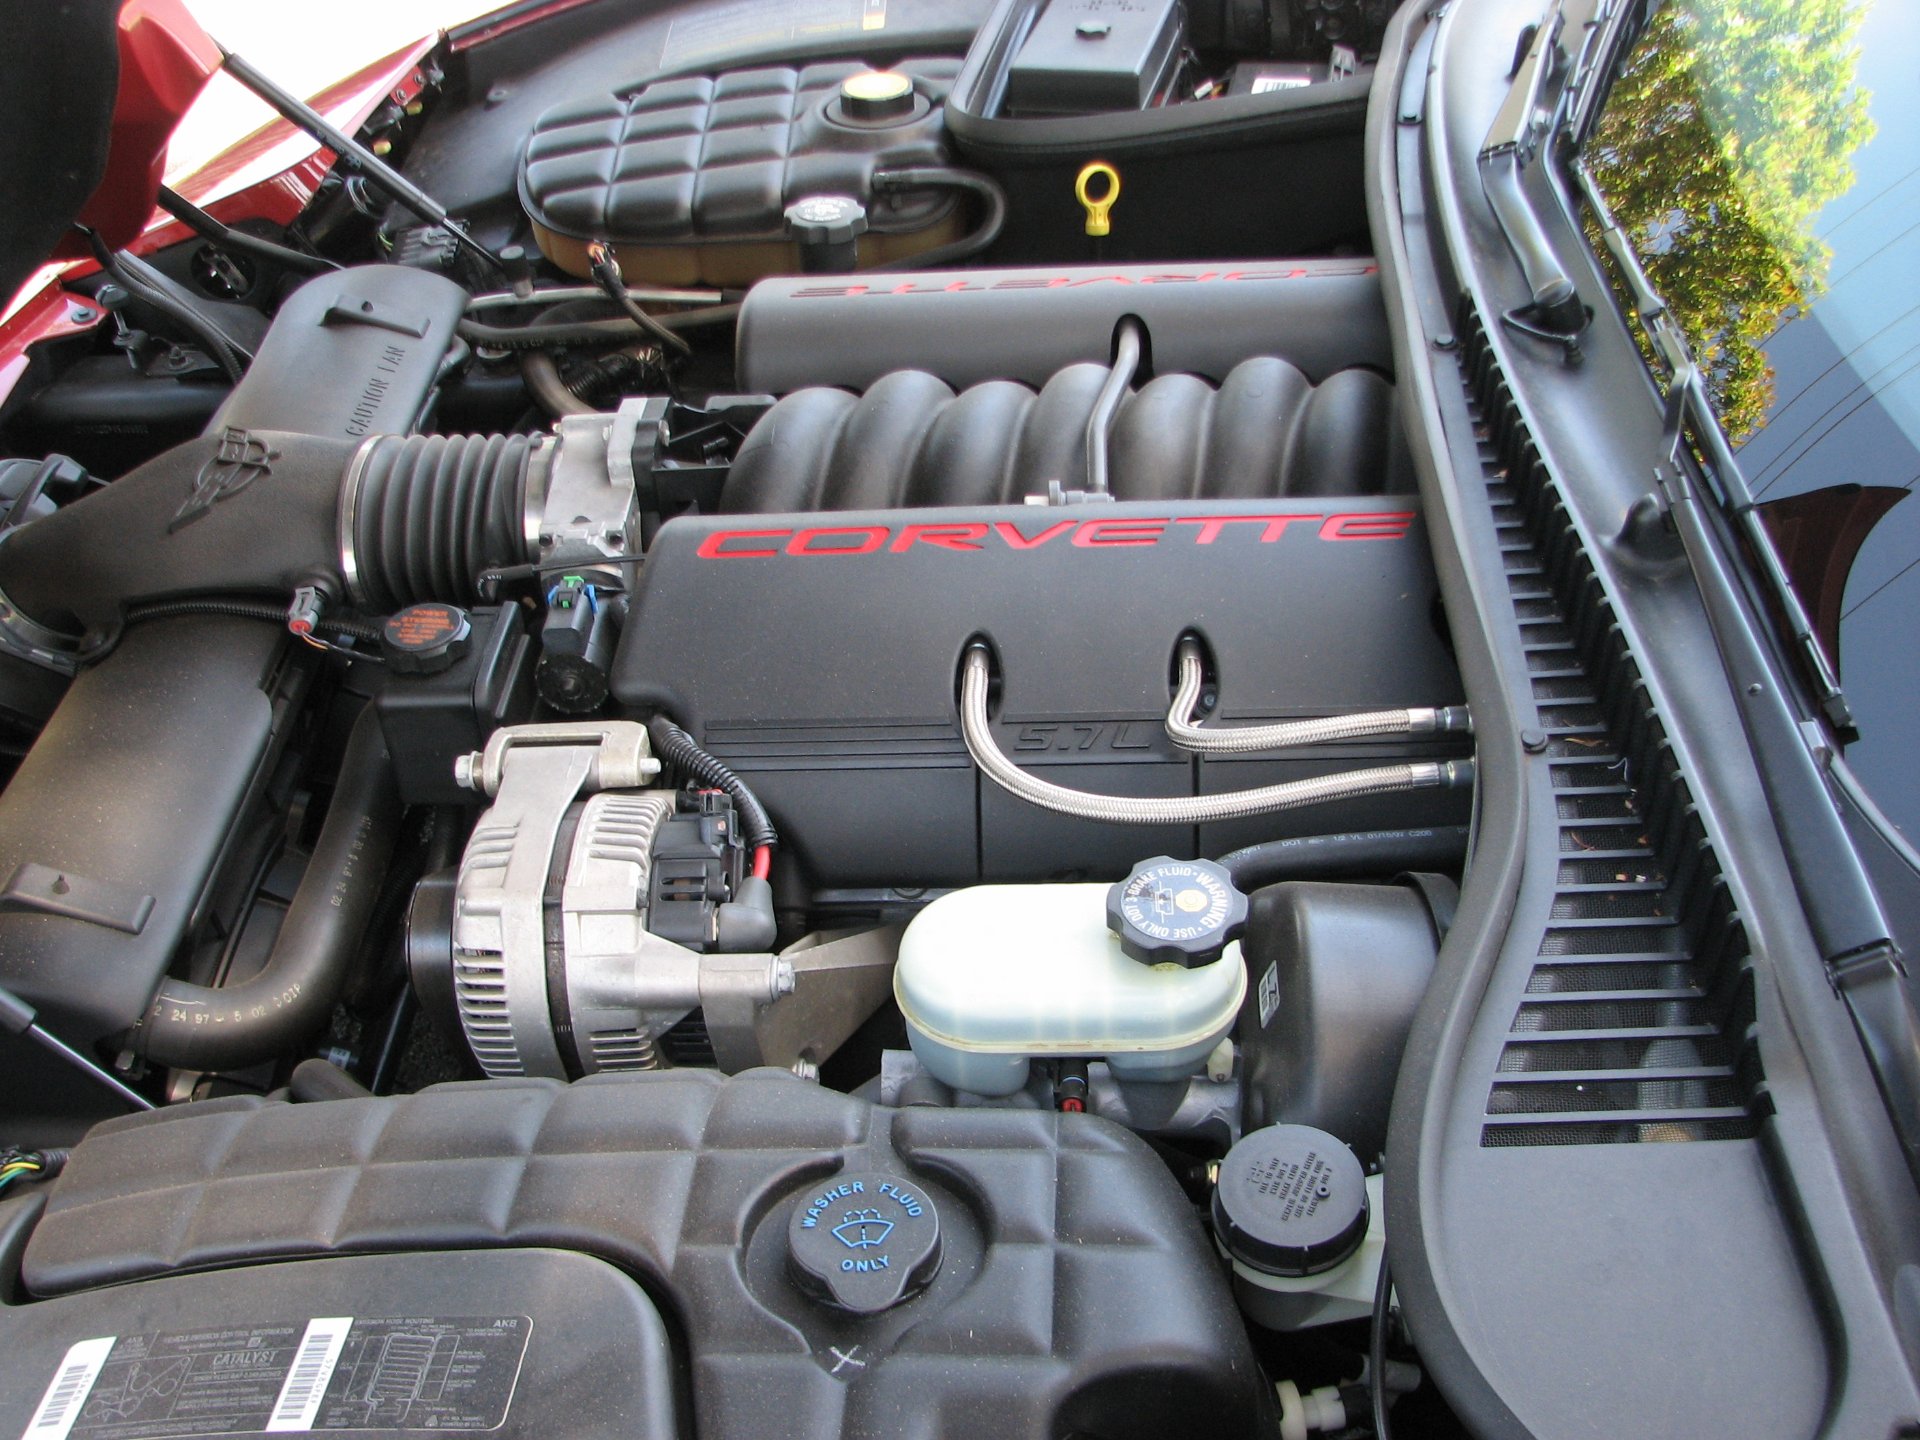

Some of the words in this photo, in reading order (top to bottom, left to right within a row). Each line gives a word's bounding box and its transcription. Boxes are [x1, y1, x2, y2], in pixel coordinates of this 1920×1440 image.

[345, 378, 390, 436] CAUTION
[697, 511, 1416, 560] CORVETTE
[1014, 722, 1151, 751] 5.7L
[1157, 866, 1192, 877] FLUID
[1127, 871, 1158, 896] BRAKE
[1195, 872, 1228, 929] WARNING
[1125, 904, 1144, 922] DOT
[1139, 921, 1170, 938] ONLY
[1173, 926, 1197, 939] USE
[801, 1181, 864, 1228] WASHER
[879, 1183, 922, 1217] FLUID
[841, 1255, 889, 1272] ONLY
[213, 1350, 279, 1367] CATALYST
